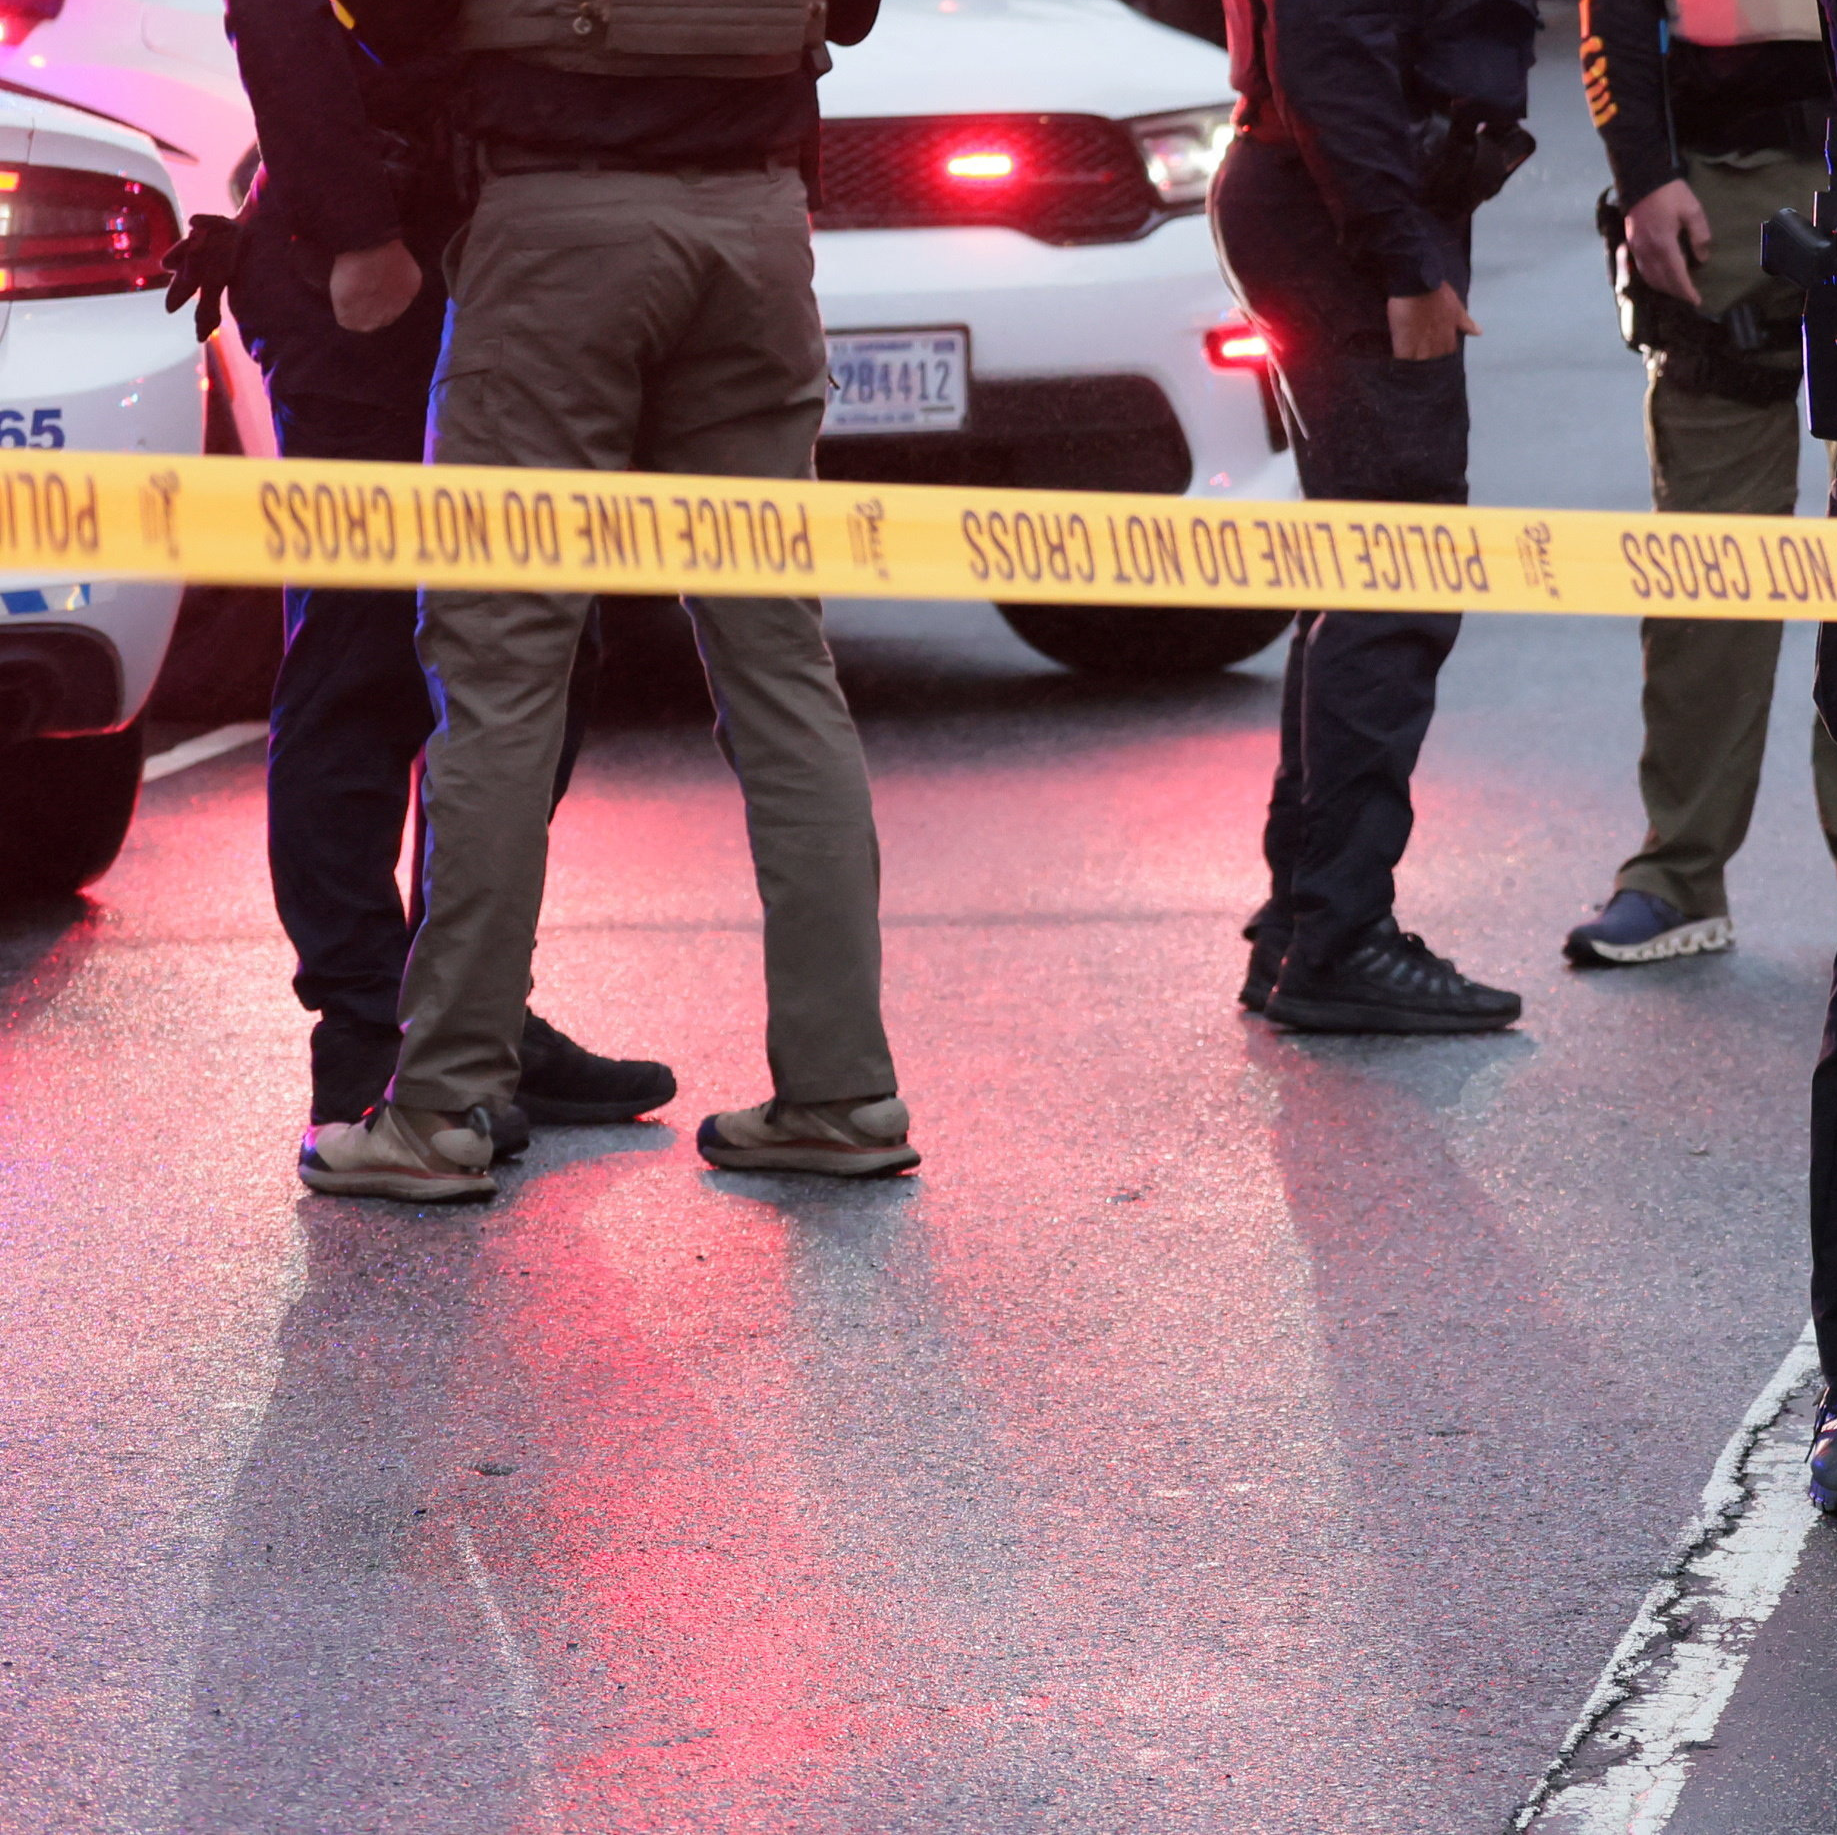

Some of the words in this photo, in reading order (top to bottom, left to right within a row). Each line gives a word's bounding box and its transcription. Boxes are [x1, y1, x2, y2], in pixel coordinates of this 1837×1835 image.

[0, 408, 66, 451] 65
[0, 471, 100, 555] POLI
[259, 480, 398, 563] CROSS
[412, 486, 493, 565] NOT
[502, 488, 562, 567] DO
[570, 492, 664, 568] LINE
[671, 496, 815, 574] POLICE
[961, 508, 1096, 585] CROSS
[1107, 514, 1186, 586] NOT
[1190, 516, 1250, 588] DO
[1252, 519, 1346, 589] LINE
[1347, 522, 1490, 594] POLICE
[1620, 530, 1752, 602] CROSS
